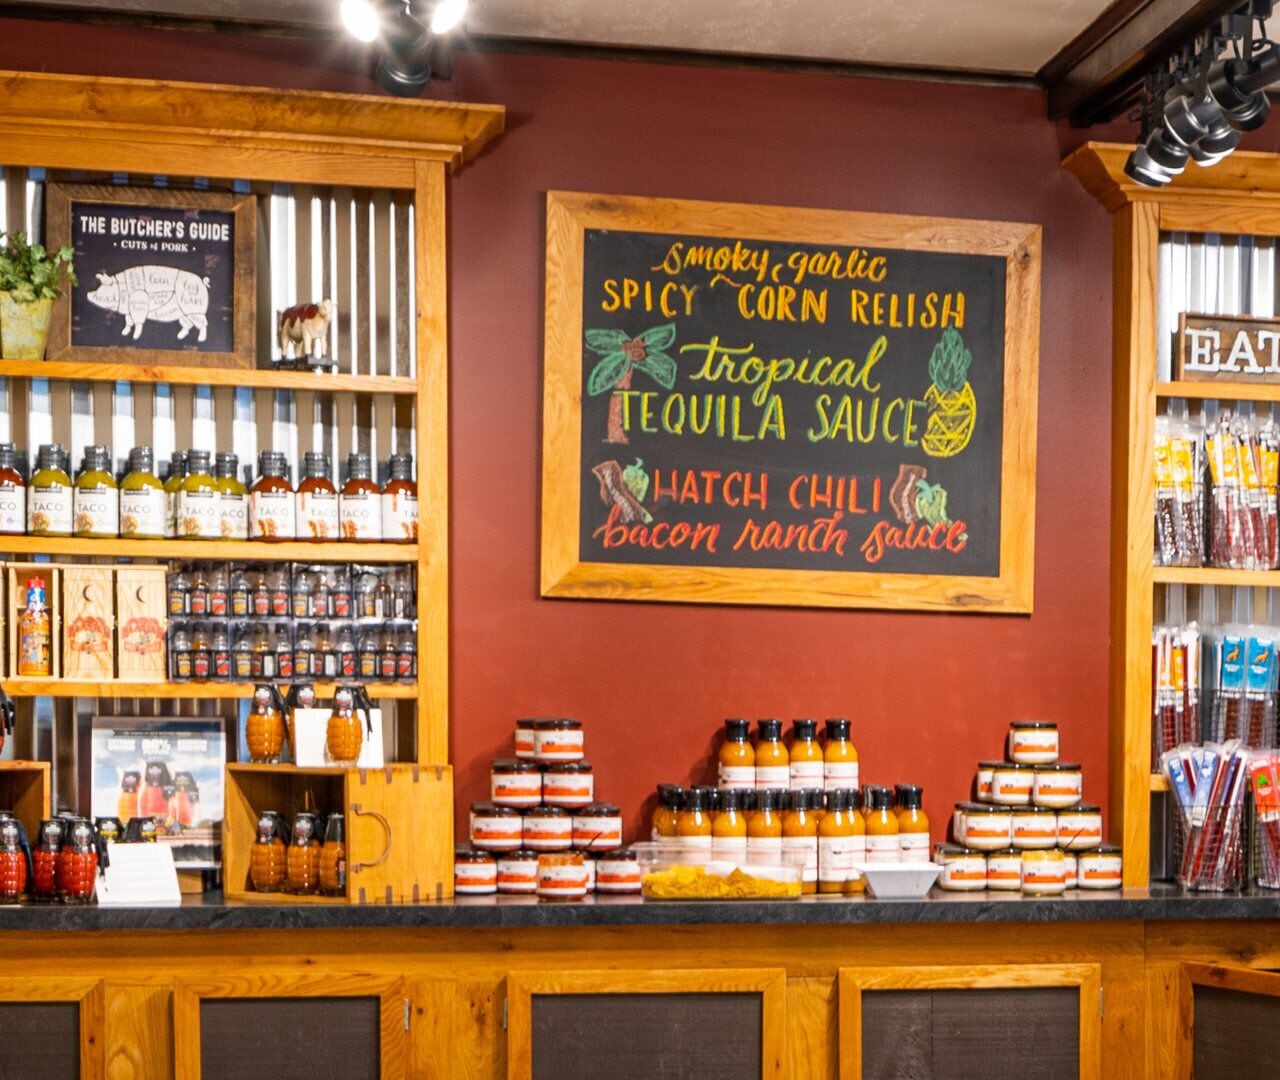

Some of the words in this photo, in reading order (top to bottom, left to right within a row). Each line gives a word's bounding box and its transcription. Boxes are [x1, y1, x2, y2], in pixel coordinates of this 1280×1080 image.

[80, 216, 106, 234] THE
[110, 217, 184, 238] BUTCHER'S
[189, 222, 230, 241] GUIDE
[120, 239, 147, 250] CUTS
[161, 242, 189, 253] PORK
[787, 249, 889, 282] garlic
[602, 278, 698, 317] SPICY
[737, 284, 828, 324] CORN
[850, 291, 967, 329] RELISH
[680, 334, 888, 406] tropical
[613, 389, 787, 442] TEQUILA
[807, 394, 927, 449] SAUCE
[653, 468, 768, 510] HATCH
[788, 473, 882, 515] CHILI
[33, 502, 64, 512] TACO
[78, 502, 107, 513] TACO
[123, 504, 151, 514] TACO
[186, 506, 216, 517] TACO
[259, 507, 290, 518] TACO
[592, 503, 722, 553] bacon
[733, 510, 847, 556] ranch
[860, 518, 969, 563] sauce
